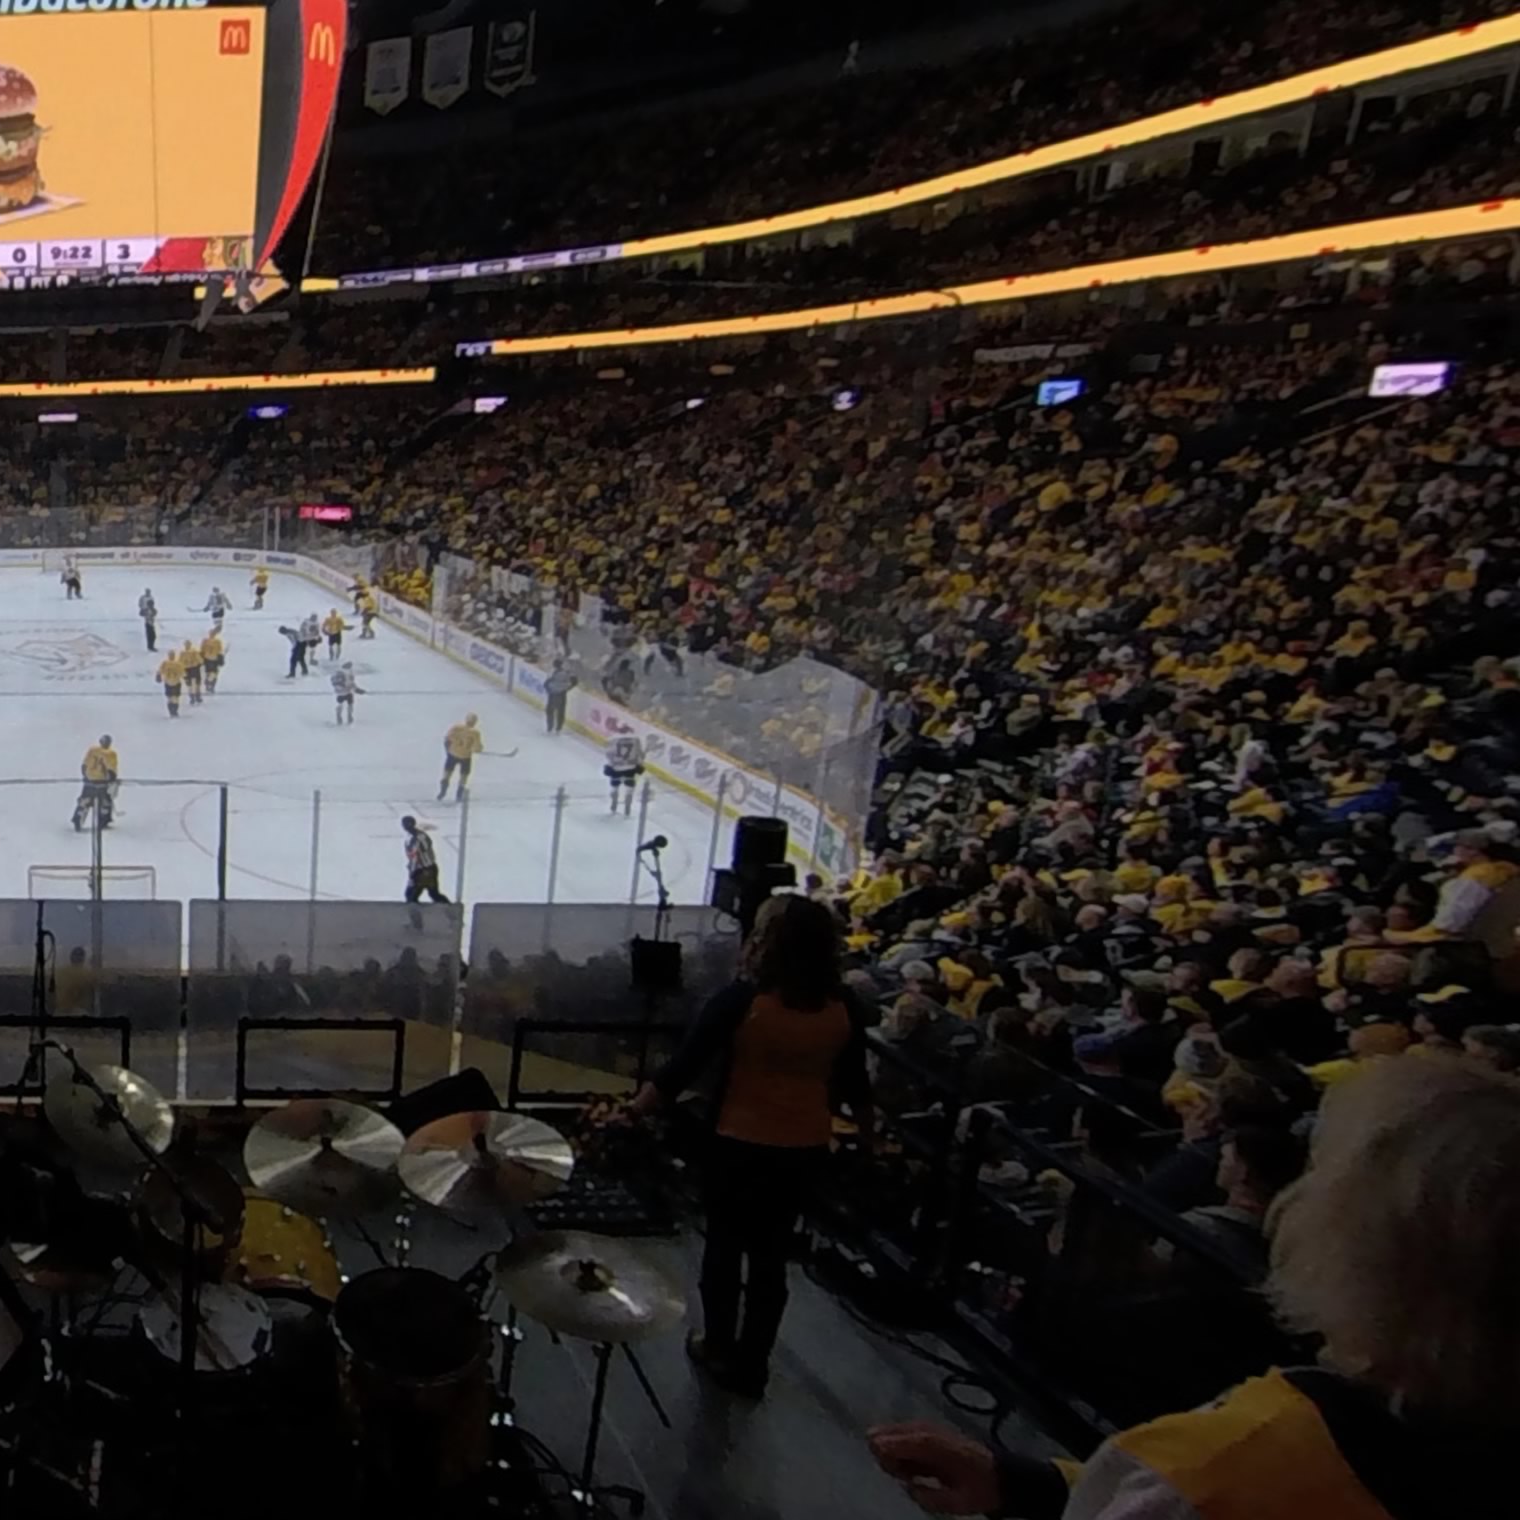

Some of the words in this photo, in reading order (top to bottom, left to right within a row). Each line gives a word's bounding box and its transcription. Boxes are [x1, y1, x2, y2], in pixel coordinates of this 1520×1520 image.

[12, 248, 27, 263] 0
[50, 246, 92, 260] 9:22
[117, 244, 131, 260] 3
